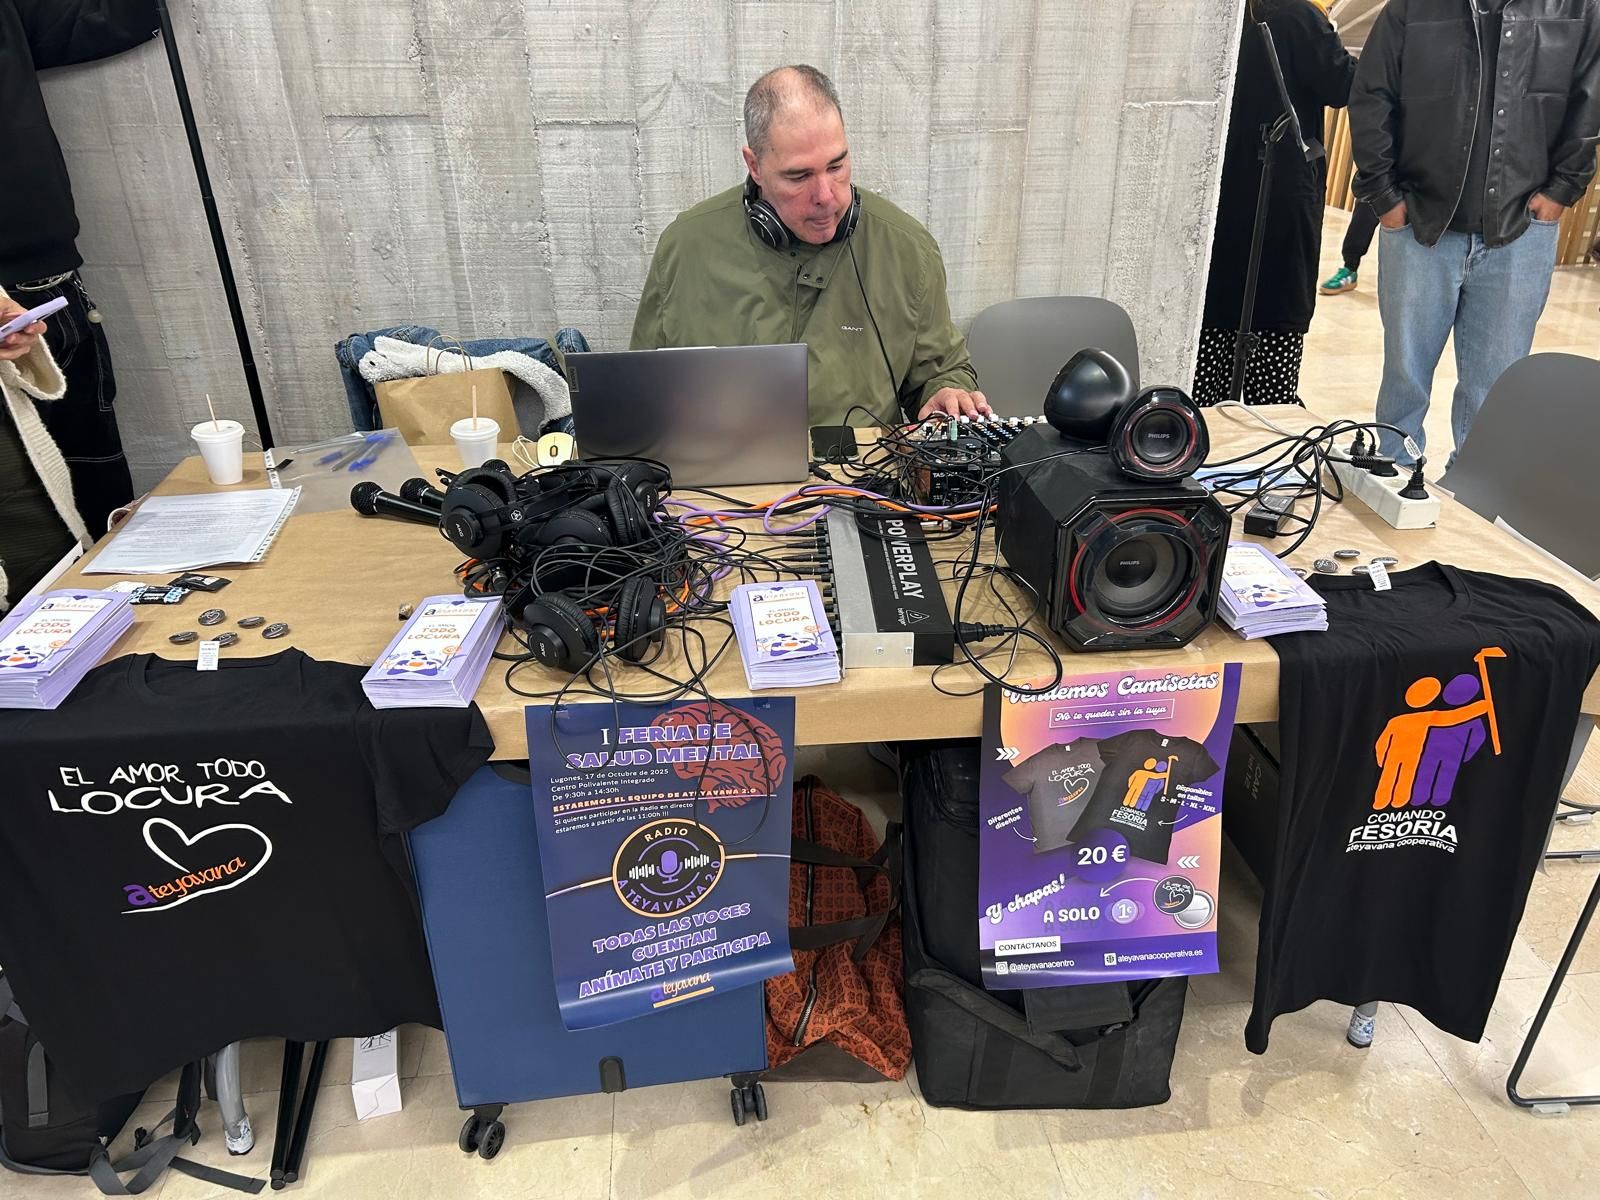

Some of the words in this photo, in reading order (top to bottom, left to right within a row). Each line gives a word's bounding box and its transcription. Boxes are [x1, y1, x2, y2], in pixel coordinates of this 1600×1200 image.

[455, 523, 464, 537] AKG
[885, 519, 925, 599] POWERPLAY
[759, 615, 810, 626] LOCURA
[1117, 672, 1219, 695] Camisetas
[1055, 712, 1071, 721] No
[1085, 709, 1115, 720] quedes
[1118, 708, 1131, 716] sin
[1134, 706, 1143, 714] la
[1146, 706, 1167, 716] tuya
[601, 728, 610, 745] I
[618, 724, 693, 744] FERIA
[697, 723, 731, 740] DE
[565, 749, 652, 769] SALUD
[656, 744, 762, 763] MENTAL
[59, 766, 95, 786] EL
[109, 763, 185, 785] AMOR
[196, 758, 265, 779] TODO
[1048, 768, 1095, 782] LOCURA
[551, 784, 577, 792] Centro
[578, 780, 619, 788] Polivalente
[620, 777, 655, 785] Integrado
[564, 790, 586, 798] 9:30h
[594, 787, 620, 795] 14:30h
[1176, 784, 1213, 797] Disponibles
[47, 780, 293, 815] LOCURA
[553, 797, 612, 813] ESTAREMOS
[627, 793, 665, 802] EQUIPO
[1187, 794, 1205, 802] tallas
[987, 806, 1023, 825] Diferentes
[1120, 806, 1146, 818] COMANDO
[1202, 804, 1216, 813] XXL
[1367, 809, 1446, 824] COMANDO
[554, 818, 561, 826] Si
[562, 815, 587, 825] quieres
[588, 811, 621, 820] participar
[555, 823, 590, 834] estaremos
[596, 817, 616, 826] partir
[1111, 809, 1148, 827] FESORIA
[644, 827, 688, 842] RADIO
[1348, 819, 1458, 844] FESORIA
[1345, 841, 1395, 853] ateyavana
[1396, 838, 1455, 853] cooperativa
[1077, 846, 1107, 865] 20
[1111, 845, 1127, 863] €
[121, 855, 247, 906] ateyavana
[985, 902, 1003, 924] Y
[1007, 873, 1065, 912] chapas!
[1043, 910, 1054, 923] A
[1058, 906, 1100, 922] SOLO
[592, 925, 656, 954] TODAS
[657, 917, 691, 936] LAS
[692, 903, 751, 927] VOCES
[632, 927, 717, 962] CUENTAN
[579, 961, 665, 998] ANÍMATE
[664, 956, 679, 972] Y
[680, 931, 771, 969] PARTICIPA
[1009, 959, 1075, 973] @ateyavanacentro
[1117, 949, 1203, 963] ateyavanacooperativa.es
[651, 972, 711, 1001] ateyavana
